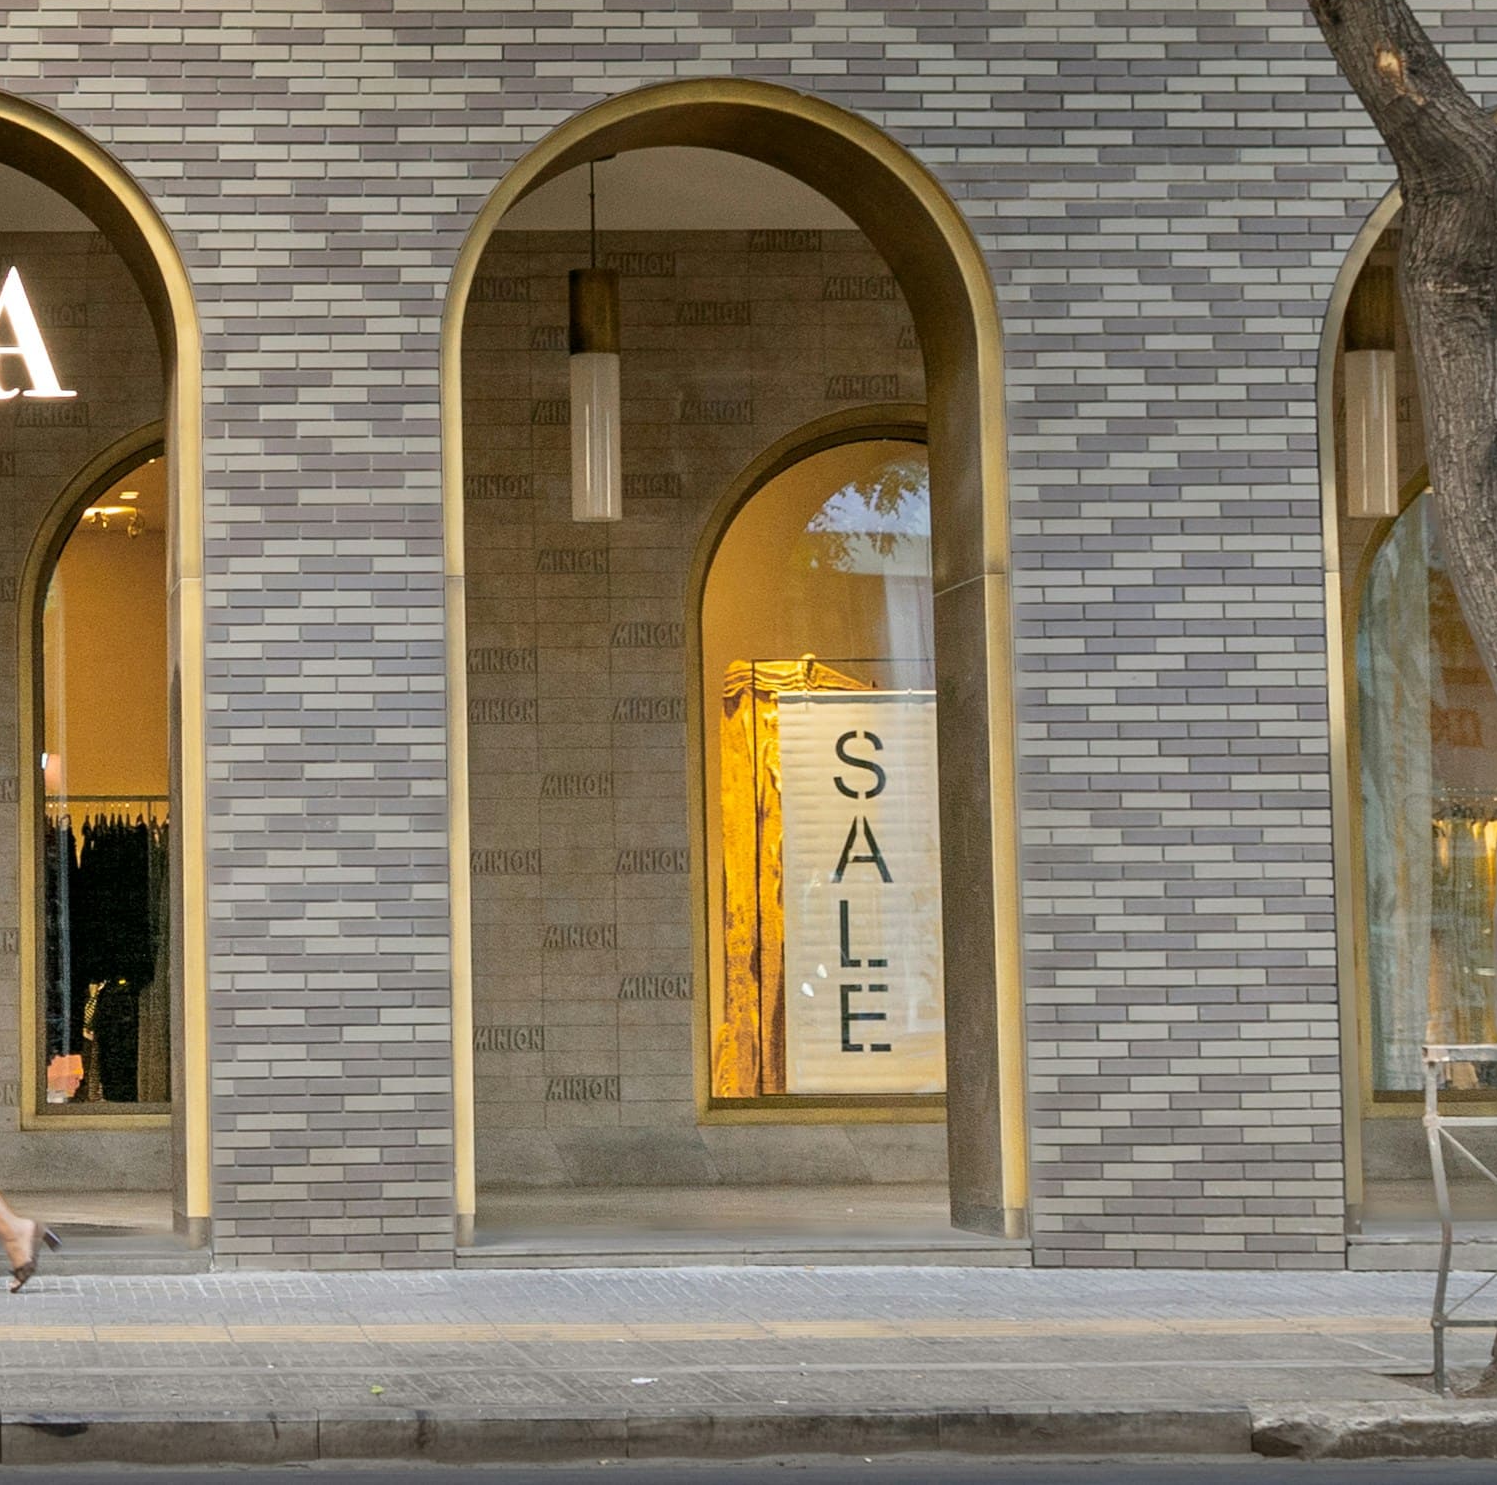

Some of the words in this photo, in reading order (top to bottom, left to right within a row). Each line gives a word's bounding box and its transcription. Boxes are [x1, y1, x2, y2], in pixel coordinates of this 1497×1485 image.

[678, 301, 751, 325] MINION
[532, 325, 568, 349] MIN
[825, 375, 899, 400] MINION
[532, 400, 570, 423] MIN
[536, 547, 608, 573] MINION
[611, 621, 684, 647] MINION
[467, 647, 537, 672] MINION
[468, 697, 538, 722] MINION
[612, 696, 686, 722] MINION
[541, 772, 613, 798] MINION
[471, 849, 541, 873] MINION
[616, 848, 689, 873] MINION
[832, 729, 893, 1053] SALE
[543, 923, 616, 949] MINION
[617, 973, 692, 999] MINION
[474, 1025, 544, 1051] MINION
[545, 1075, 620, 1101] MINION
